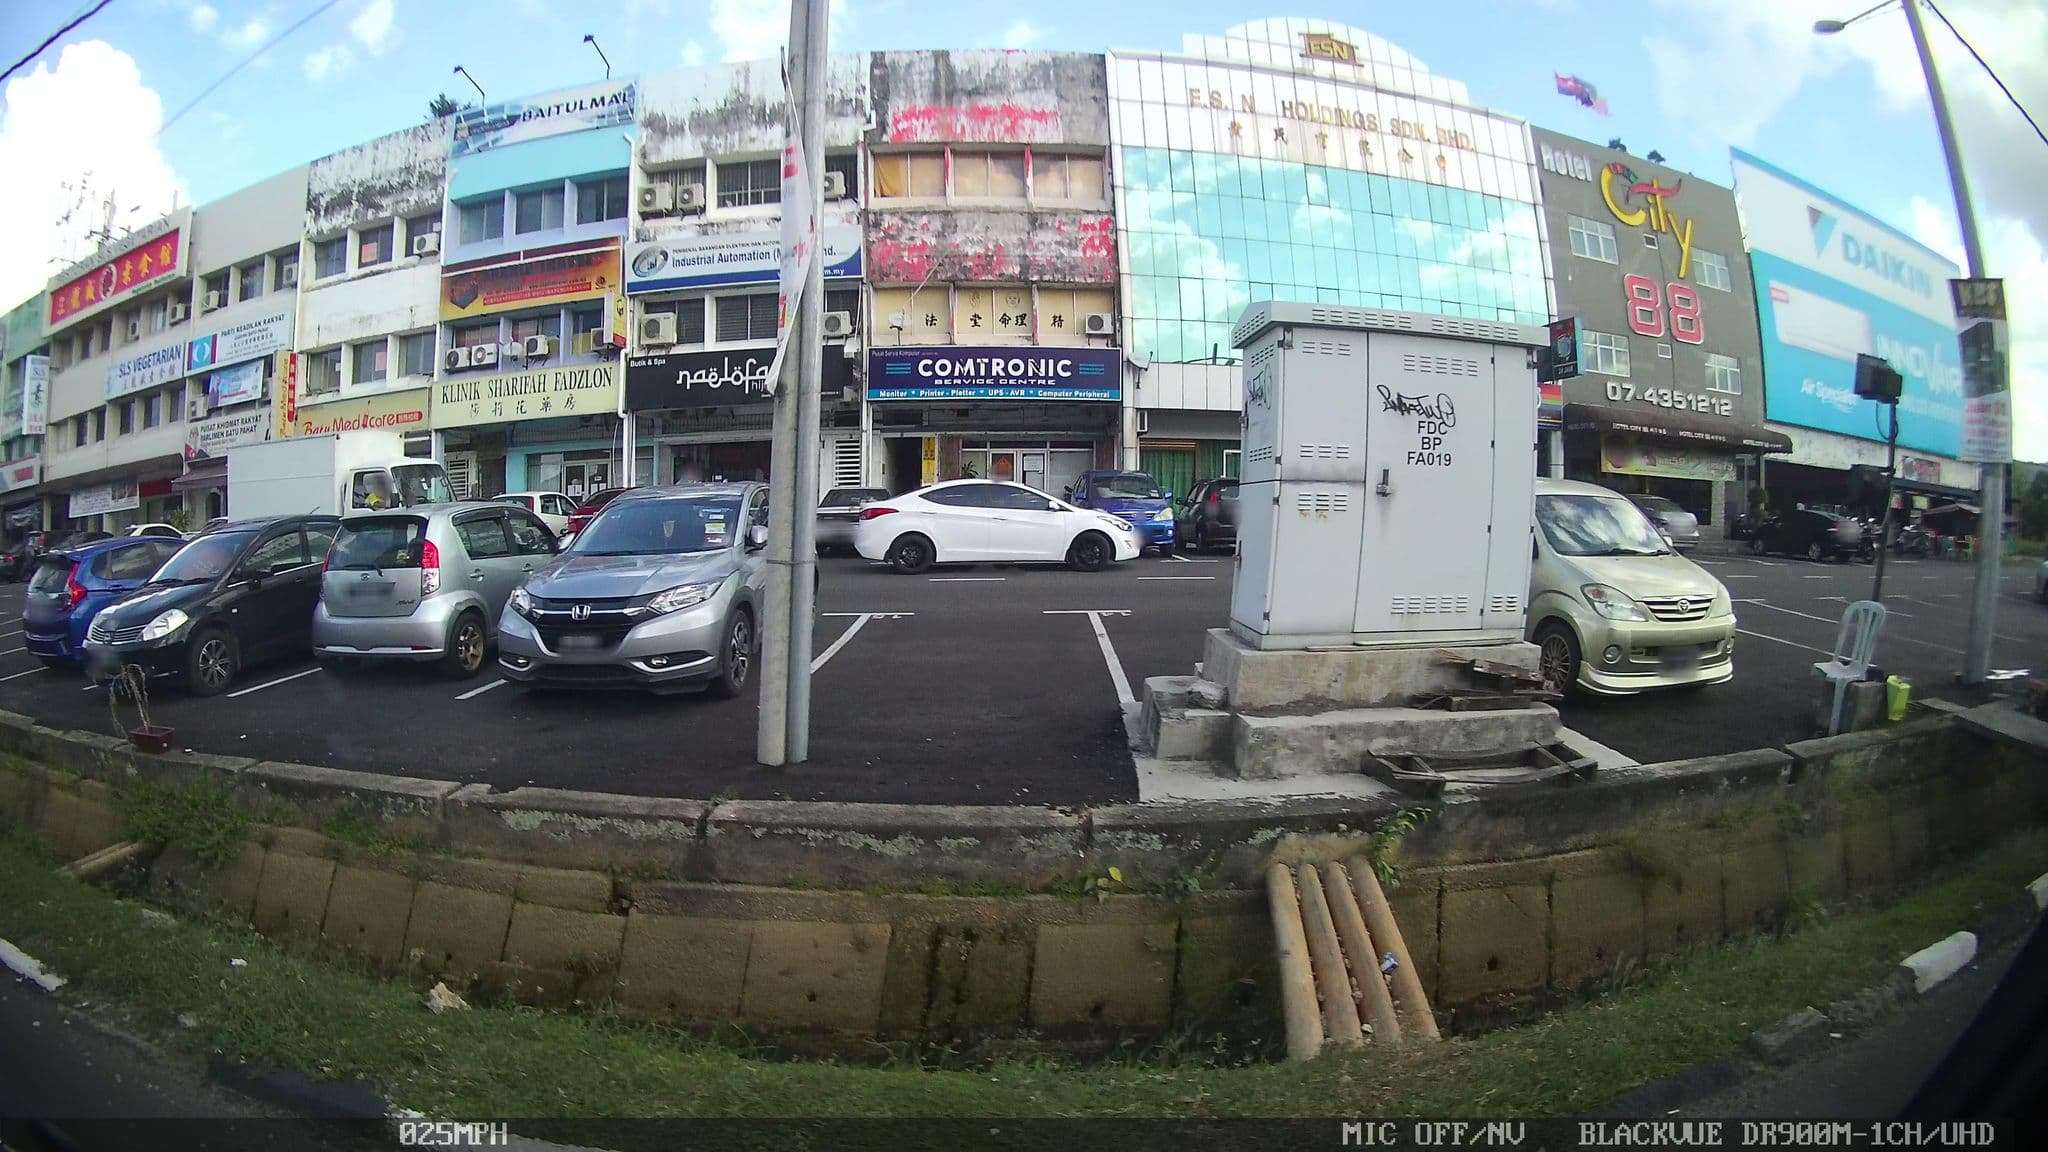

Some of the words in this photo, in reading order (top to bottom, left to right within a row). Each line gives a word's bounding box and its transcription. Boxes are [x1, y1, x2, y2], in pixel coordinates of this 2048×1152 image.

[1281, 99, 1378, 132] HOLDINGS
[1541, 144, 1593, 182] Hotel
[1600, 162, 1693, 279] City
[672, 254, 715, 268] Industrial
[717, 249, 770, 264] Automation
[1841, 232, 1933, 299] DAIKIN
[1624, 273, 1705, 345] 88
[132, 344, 182, 374] VEGETARIAN
[630, 359, 647, 368] Butik
[654, 358, 666, 367] Spa
[918, 358, 1072, 377] COMTRONIC
[442, 382, 481, 404] KLINIK
[488, 374, 546, 399] SHARIFAH
[554, 367, 612, 392] FADZLON
[919, 389, 945, 397] Printer
[1038, 390, 1072, 398] Computer
[1606, 381, 1732, 417] 07-4351212
[241, 414, 262, 424] RAKYAT
[1418, 421, 1448, 435] FDC
[240, 425, 257, 434] PAHAT
[1421, 436, 1442, 450] BP
[1407, 451, 1452, 467] FA019
